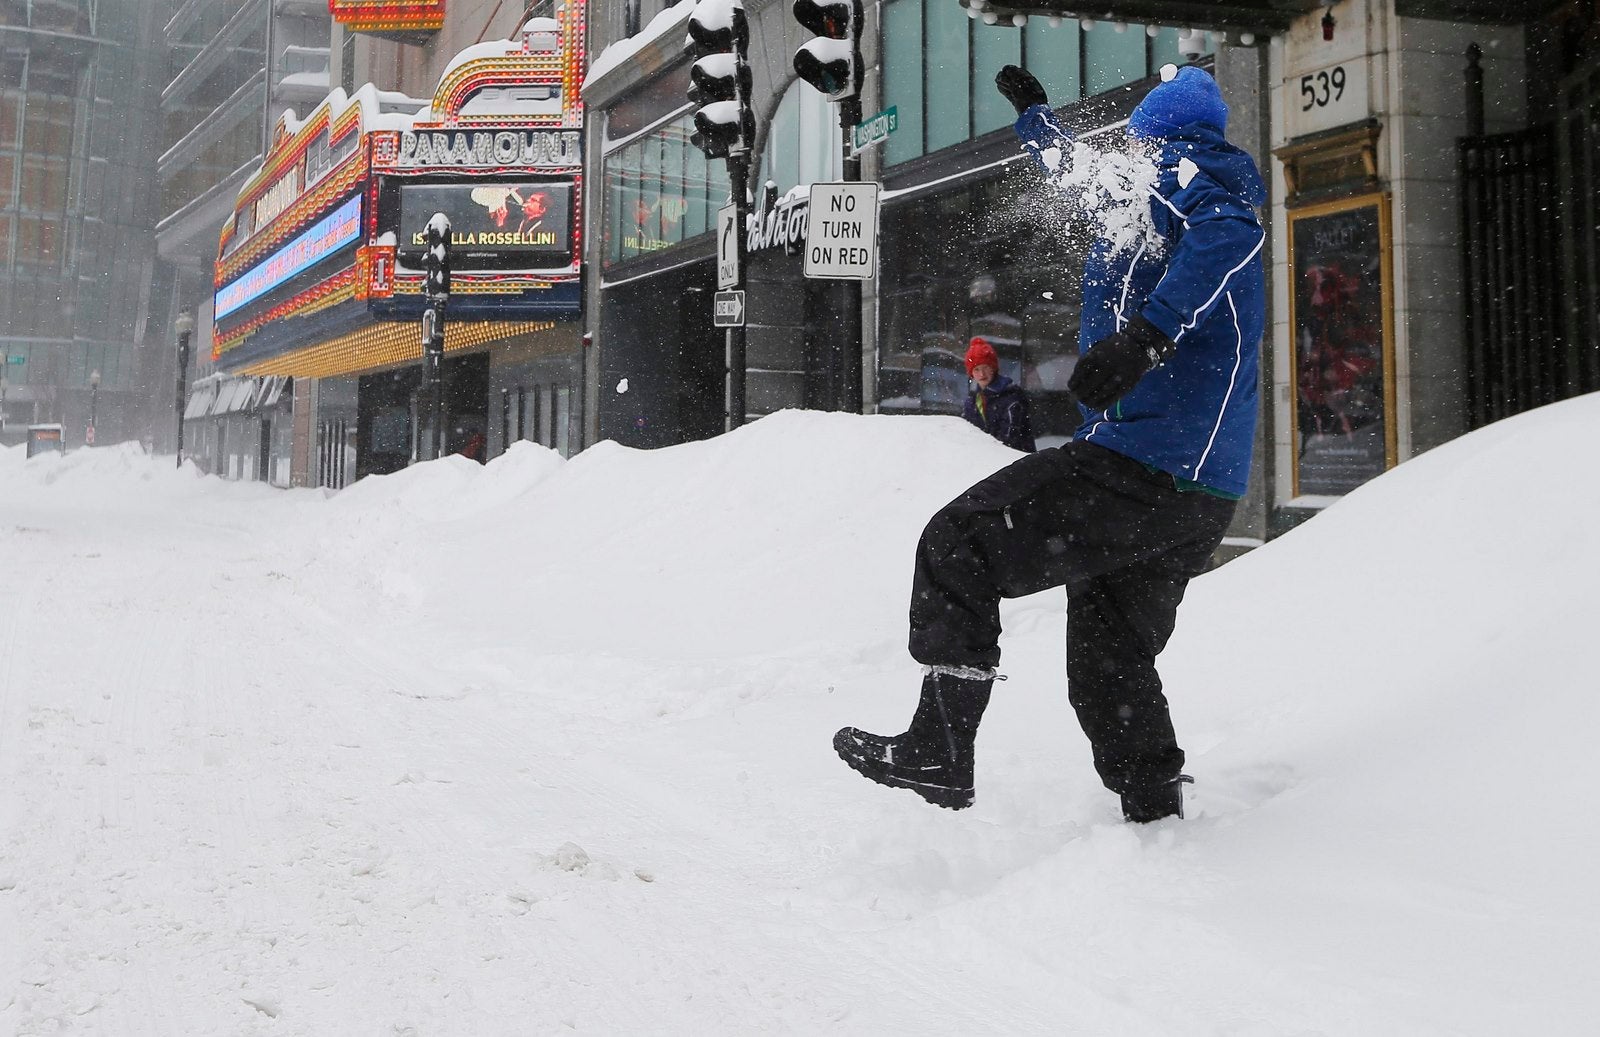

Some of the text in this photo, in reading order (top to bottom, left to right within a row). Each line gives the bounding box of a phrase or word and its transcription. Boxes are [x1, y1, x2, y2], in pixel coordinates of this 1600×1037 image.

[1301, 66, 1346, 112] 539
[889, 114, 896, 130] ST
[401, 131, 579, 164] PARAMOUNT
[831, 194, 856, 213] NO
[412, 232, 556, 245] ISLLA ROSSELLINI
[822, 221, 862, 239] TURN
[811, 246, 869, 266] ON RED
[720, 261, 736, 281] ONLY
